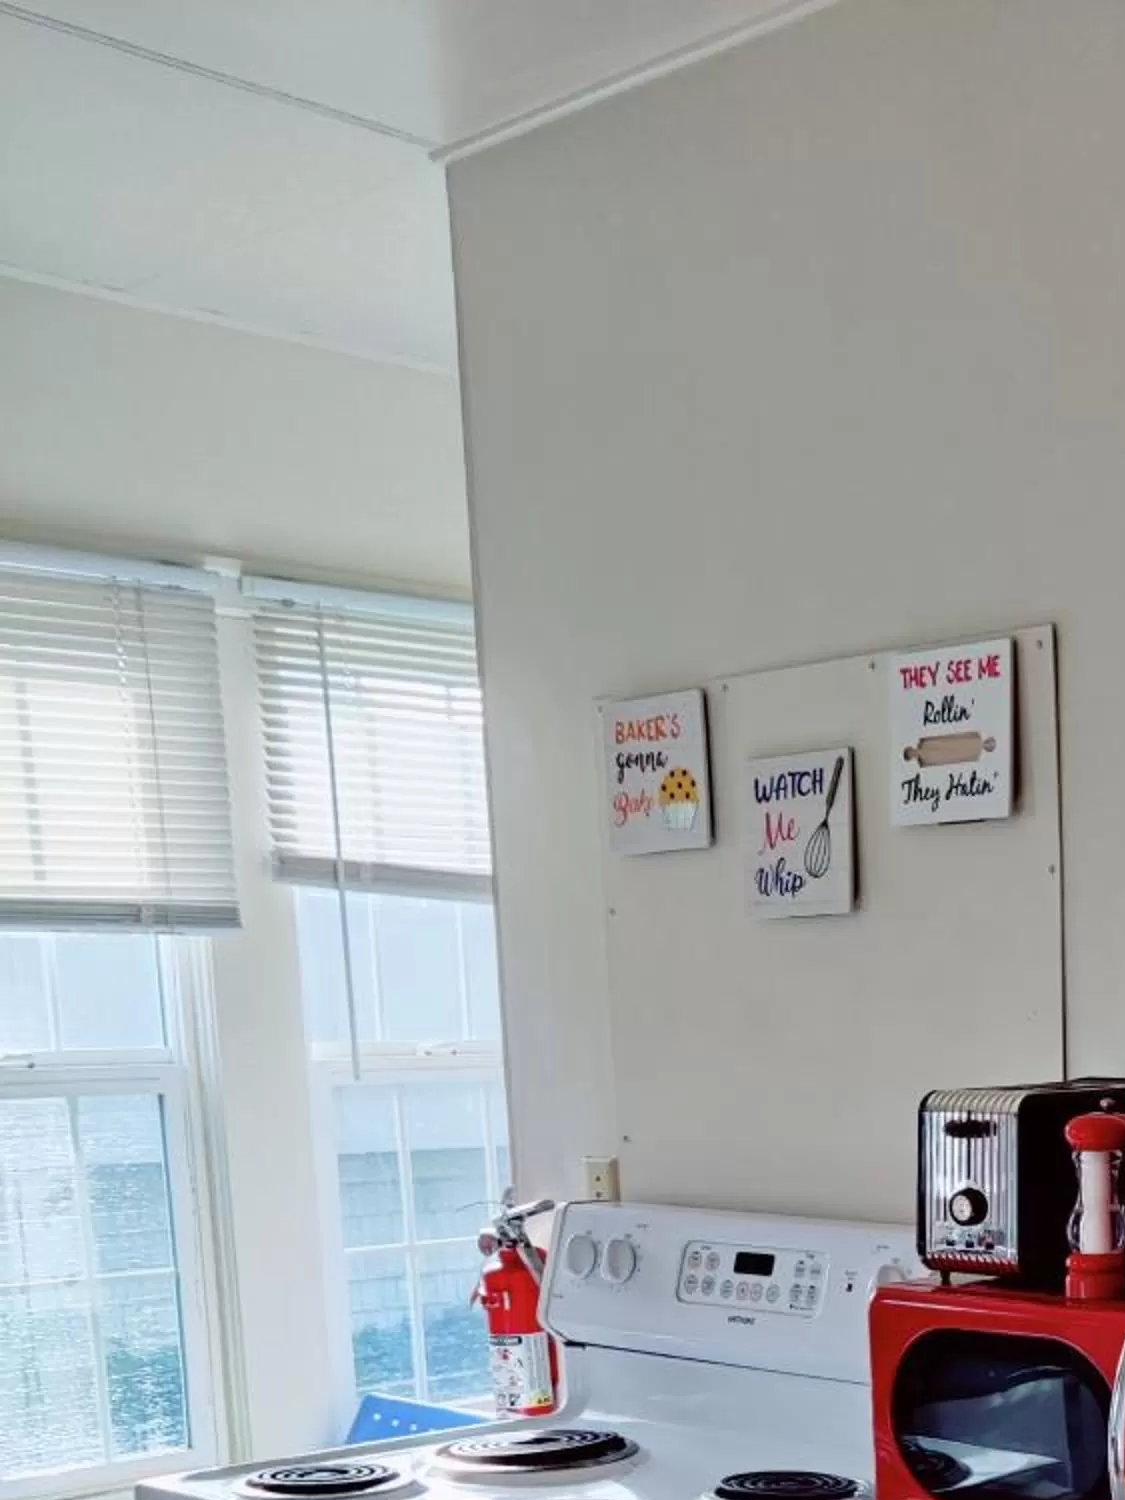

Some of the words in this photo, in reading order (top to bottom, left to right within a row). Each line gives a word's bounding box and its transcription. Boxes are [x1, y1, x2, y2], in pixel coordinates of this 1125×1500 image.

[900, 661, 940, 689] THEY
[945, 659, 972, 684] SEE
[977, 654, 1001, 680] ME
[615, 713, 681, 744] BAKER'S
[923, 694, 975, 726] Rollin'
[754, 767, 824, 804] WATCH
[901, 773, 940, 812] They
[758, 811, 800, 856] Me
[754, 857, 806, 899] Whip
